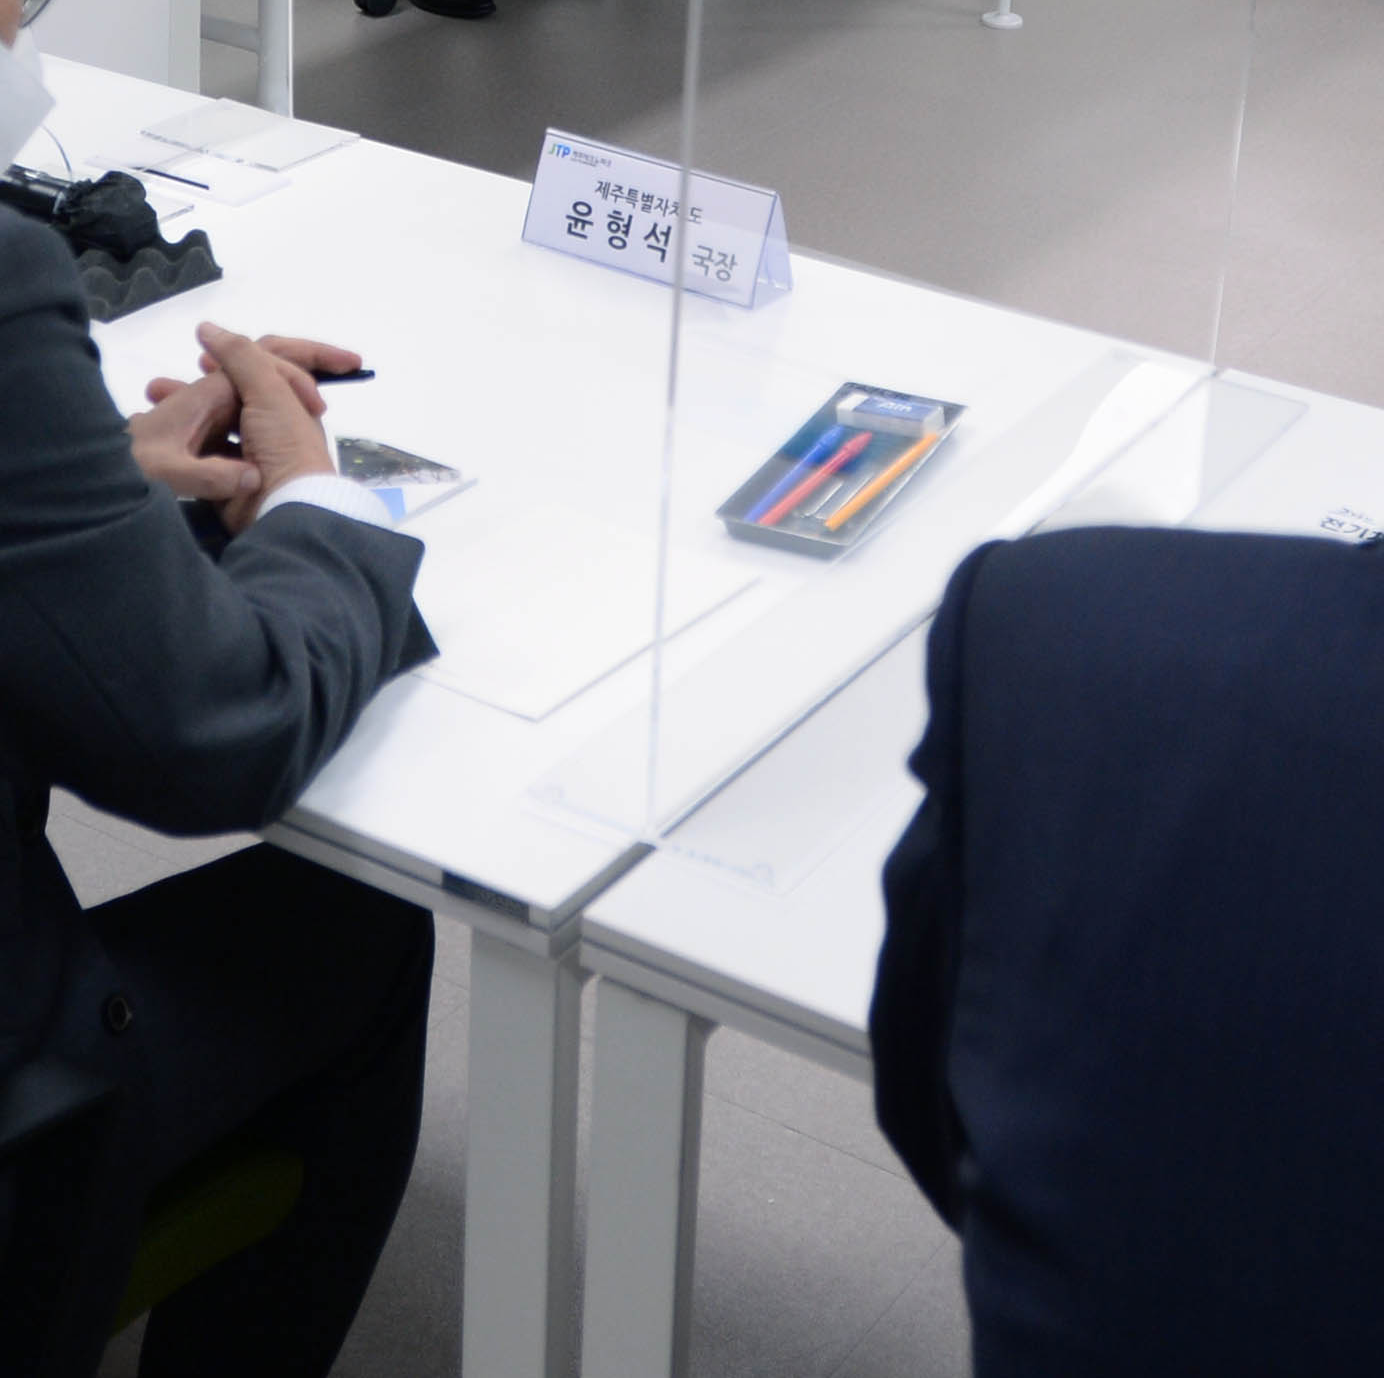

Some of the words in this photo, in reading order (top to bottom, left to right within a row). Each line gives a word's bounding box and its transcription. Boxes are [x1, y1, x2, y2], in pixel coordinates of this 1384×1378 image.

[548, 143, 572, 158] JTP
[565, 199, 672, 263] 윤형석
[692, 244, 738, 282] 국장
